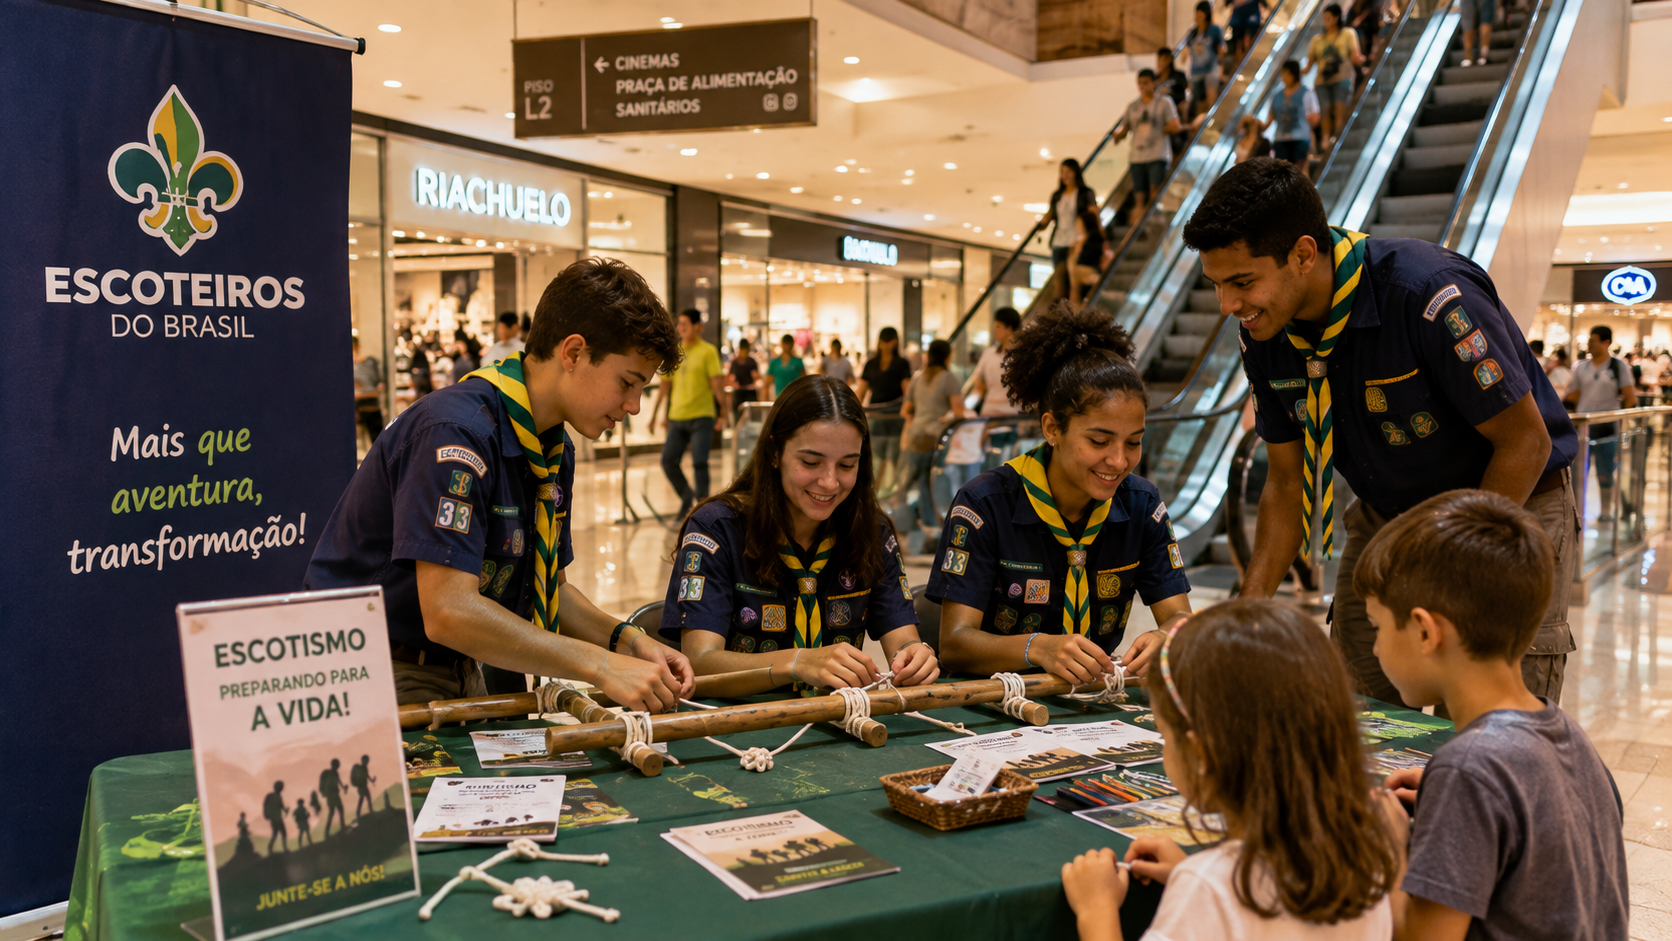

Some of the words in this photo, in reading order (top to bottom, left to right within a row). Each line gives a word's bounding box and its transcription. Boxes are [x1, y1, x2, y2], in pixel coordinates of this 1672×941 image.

[615, 53, 680, 71] CINEMAS
[524, 79, 554, 94] PISO
[616, 77, 665, 96] PRAÇA
[669, 76, 688, 92] DE
[691, 66, 798, 90] ALIMENTAÇÃO
[525, 95, 553, 120] L2
[615, 96, 701, 118] SANITÁRIOS
[417, 167, 572, 227] RIACHUELO
[45, 266, 306, 310] ESCOTEIROS
[111, 313, 154, 338] DO
[164, 314, 255, 338] BRASIL
[110, 423, 185, 462] Mais
[198, 428, 252, 466] que
[111, 474, 263, 514] aventura,
[67, 512, 307, 575] transformação!
[214, 628, 366, 668] ESCOTISMO
[219, 671, 327, 700] PREPARANDO
[330, 665, 370, 684] PARA
[251, 705, 271, 731] A
[277, 691, 351, 726] VIDA!
[256, 876, 333, 911] JUNTE-SE
[335, 874, 347, 891] A
